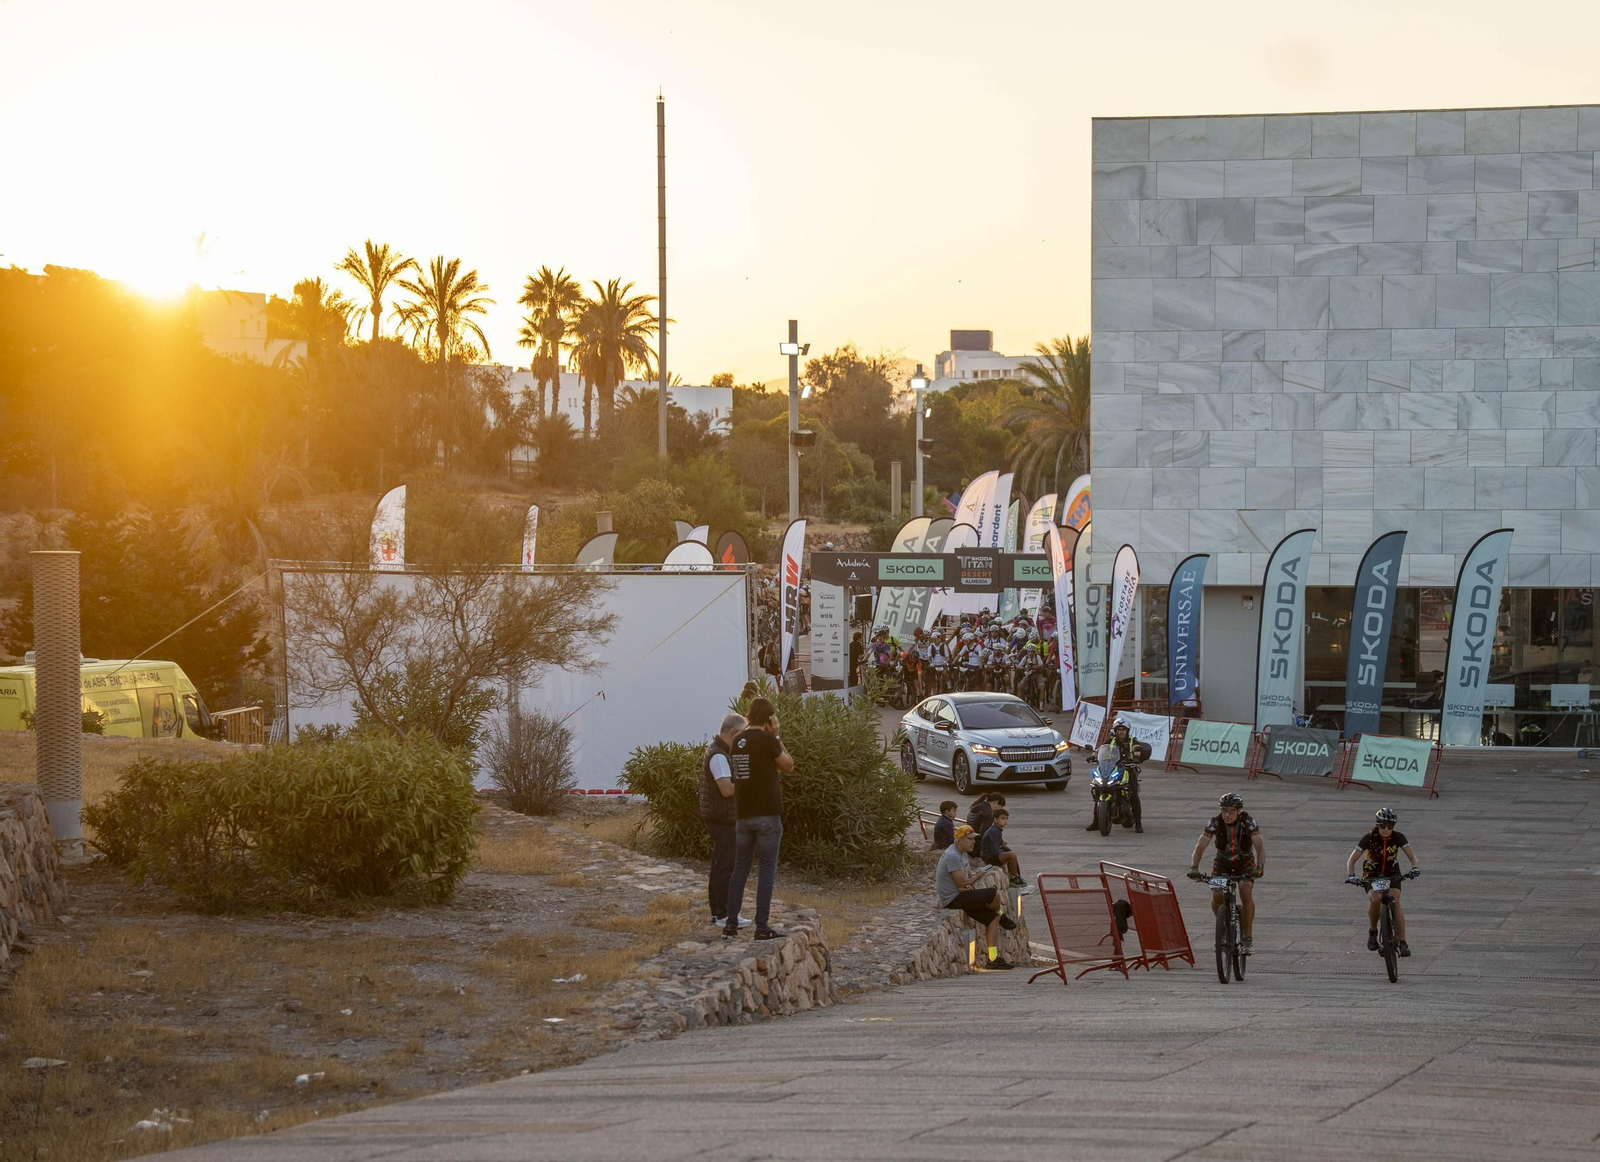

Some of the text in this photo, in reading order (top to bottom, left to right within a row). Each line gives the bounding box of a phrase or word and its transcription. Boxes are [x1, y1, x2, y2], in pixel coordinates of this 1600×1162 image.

[785, 553, 798, 634] MRW
[886, 566, 936, 574] SKODA
[1175, 571, 1196, 691] UNIVERSAE
[1270, 556, 1301, 680] SKODA
[1357, 559, 1392, 686] SKODA
[1459, 558, 1498, 689] SKODA
[1189, 738, 1240, 754] SKODA
[1273, 740, 1329, 757] SKODA
[1362, 753, 1419, 772] SKODA
